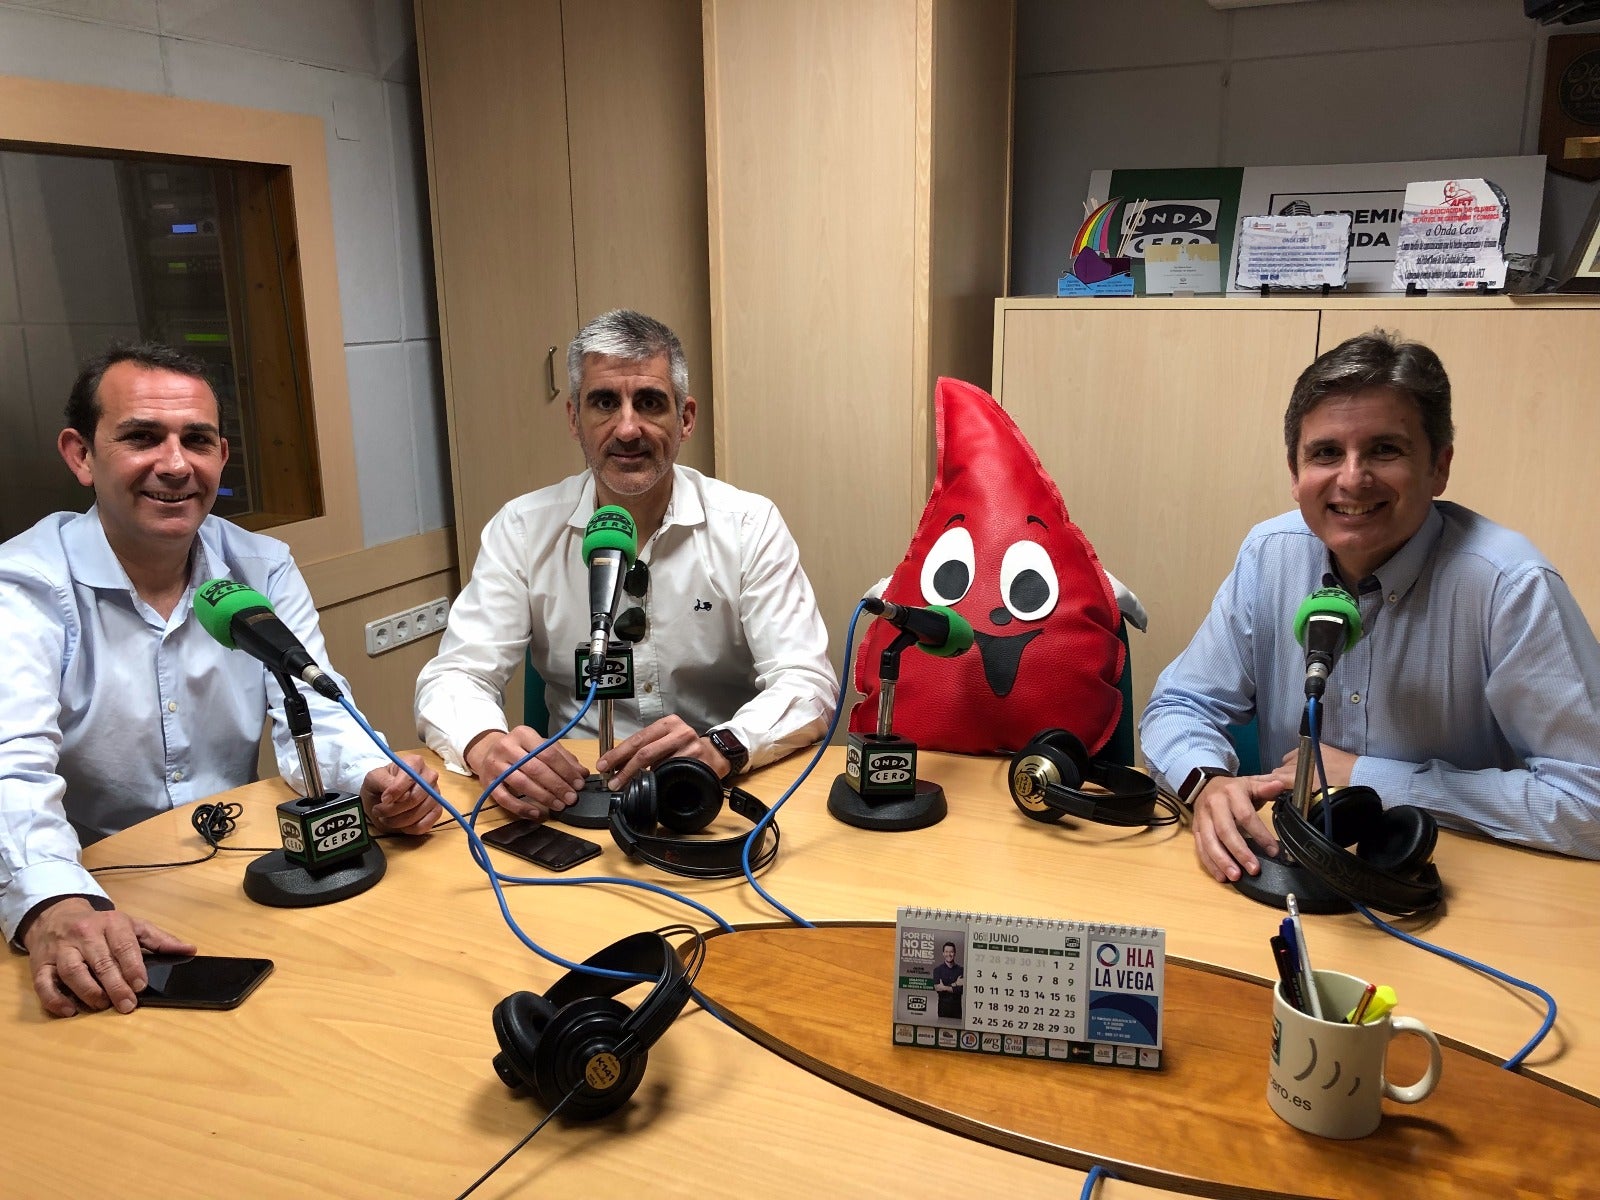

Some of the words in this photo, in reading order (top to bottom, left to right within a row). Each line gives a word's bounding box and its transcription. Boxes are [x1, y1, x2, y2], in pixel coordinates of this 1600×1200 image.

[1134, 212, 1203, 227] ONDA
[1434, 223, 1456, 236] Onda
[1460, 223, 1478, 235] Cero
[874, 759, 906, 767] ONDA
[875, 772, 905, 780] CERO
[318, 816, 354, 834] ONDA
[323, 830, 356, 848] CERO
[903, 931, 920, 940] POR
[921, 932, 934, 941] FIN
[973, 931, 984, 941] 06
[989, 933, 1019, 944] JUNIO
[902, 939, 919, 949] NO
[920, 940, 935, 950] ES
[902, 948, 934, 959] LUNES
[1126, 947, 1155, 968] HLA
[1053, 961, 1059, 969] 1
[976, 970, 982, 978] 3
[991, 971, 997, 979] 4
[1007, 973, 1013, 981] 5
[1022, 974, 1028, 982] 6
[1052, 977, 1059, 985] 8
[1068, 978, 1074, 986] 9
[1095, 968, 1111, 987] LA
[1116, 969, 1154, 991] VEGA
[973, 985, 984, 994] 10
[990, 987, 999, 995] 11
[1004, 988, 1014, 997] 12
[1020, 990, 1030, 998] 13
[1034, 991, 1045, 999] 14
[1050, 993, 1060, 1001] 15
[1065, 994, 1076, 1003] 16
[973, 1001, 983, 1009] 17
[988, 1003, 999, 1011] 18
[1004, 1004, 1014, 1012] 19
[1018, 1005, 1030, 1014] 20
[1034, 1007, 1044, 1015] 21
[1049, 1008, 1060, 1017] 22
[1064, 1010, 1075, 1018] 23
[972, 1016, 983, 1025] 24
[987, 1018, 998, 1026] 25
[1002, 1019, 1014, 1028] 26
[1018, 1021, 1029, 1029] 27
[1032, 1023, 1044, 1031] 28
[1048, 1024, 1060, 1033] 29
[1063, 1026, 1075, 1034] 30
